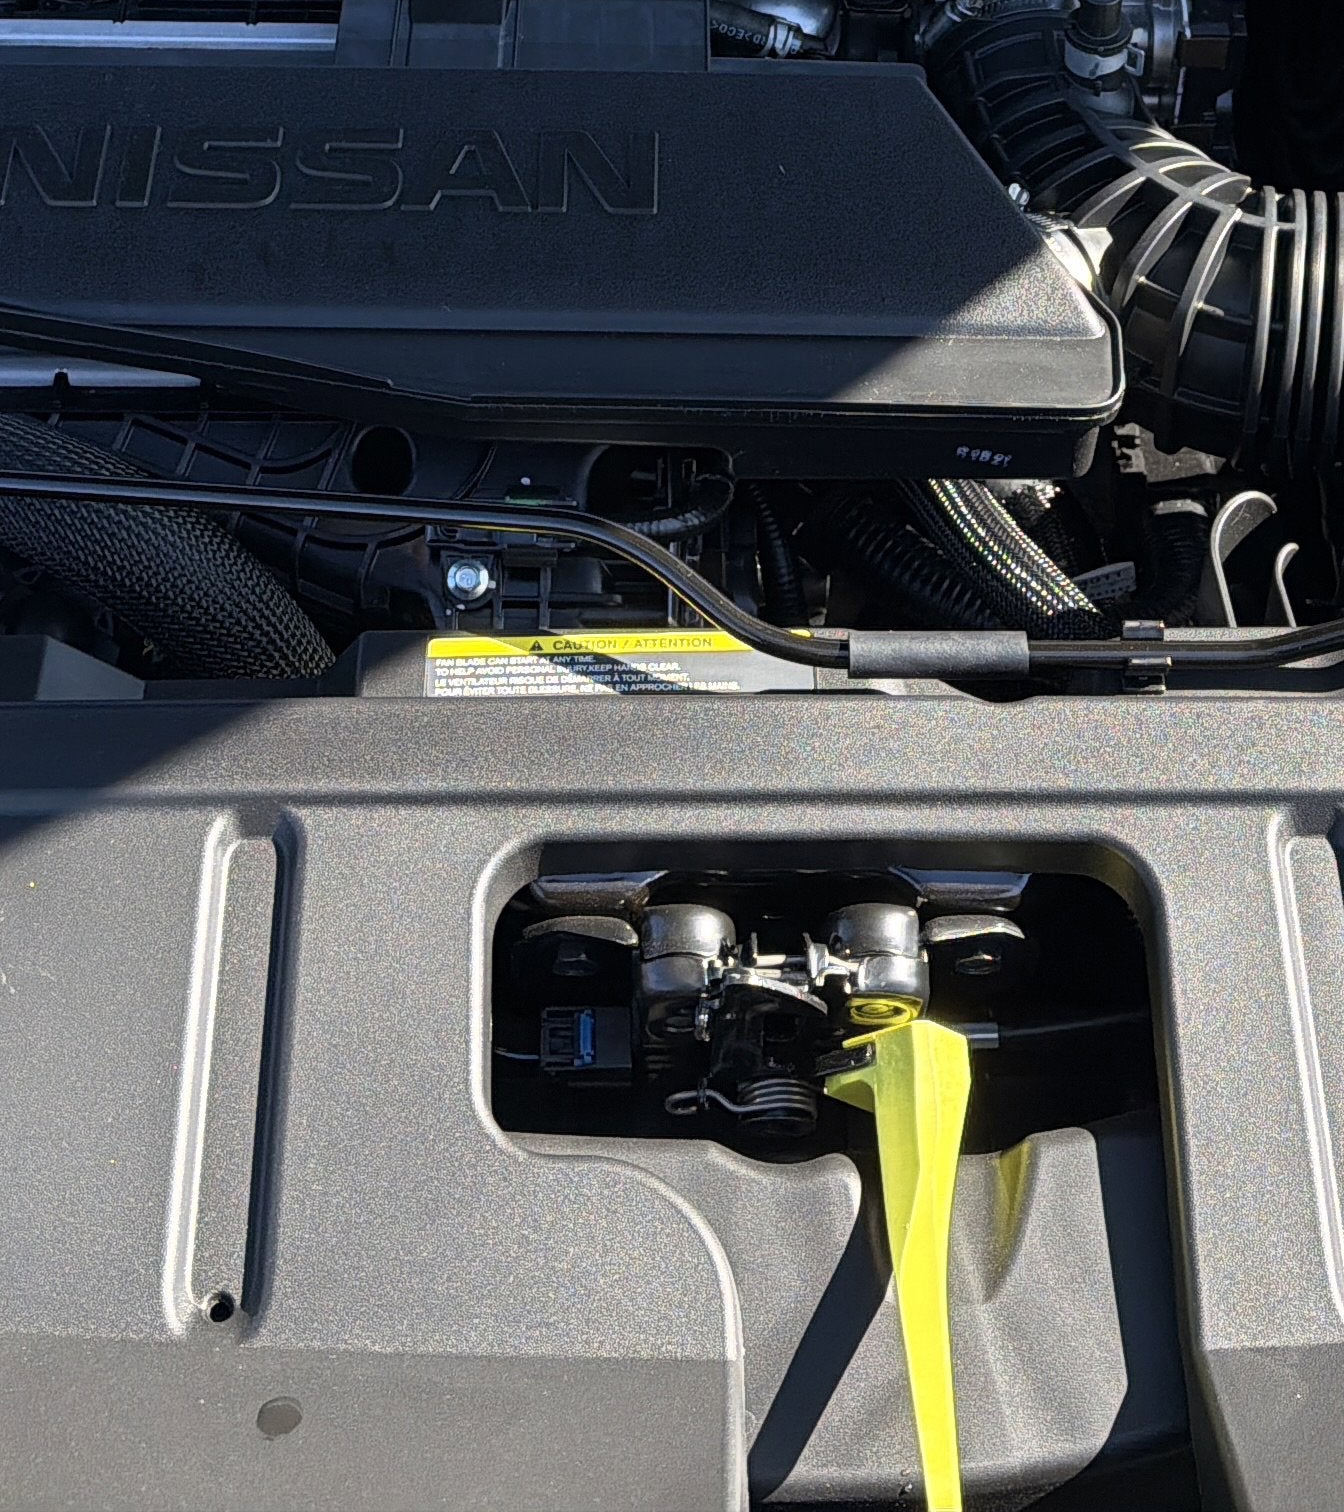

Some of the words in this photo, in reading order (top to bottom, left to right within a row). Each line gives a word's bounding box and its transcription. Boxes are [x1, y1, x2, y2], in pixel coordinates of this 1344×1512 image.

[552, 640, 617, 652] CAUTION
[633, 637, 713, 649] ATTENTION
[552, 655, 573, 664] ANY
[574, 655, 597, 663] TIME.
[621, 673, 647, 682] TOUT
[615, 683, 629, 692] EN
